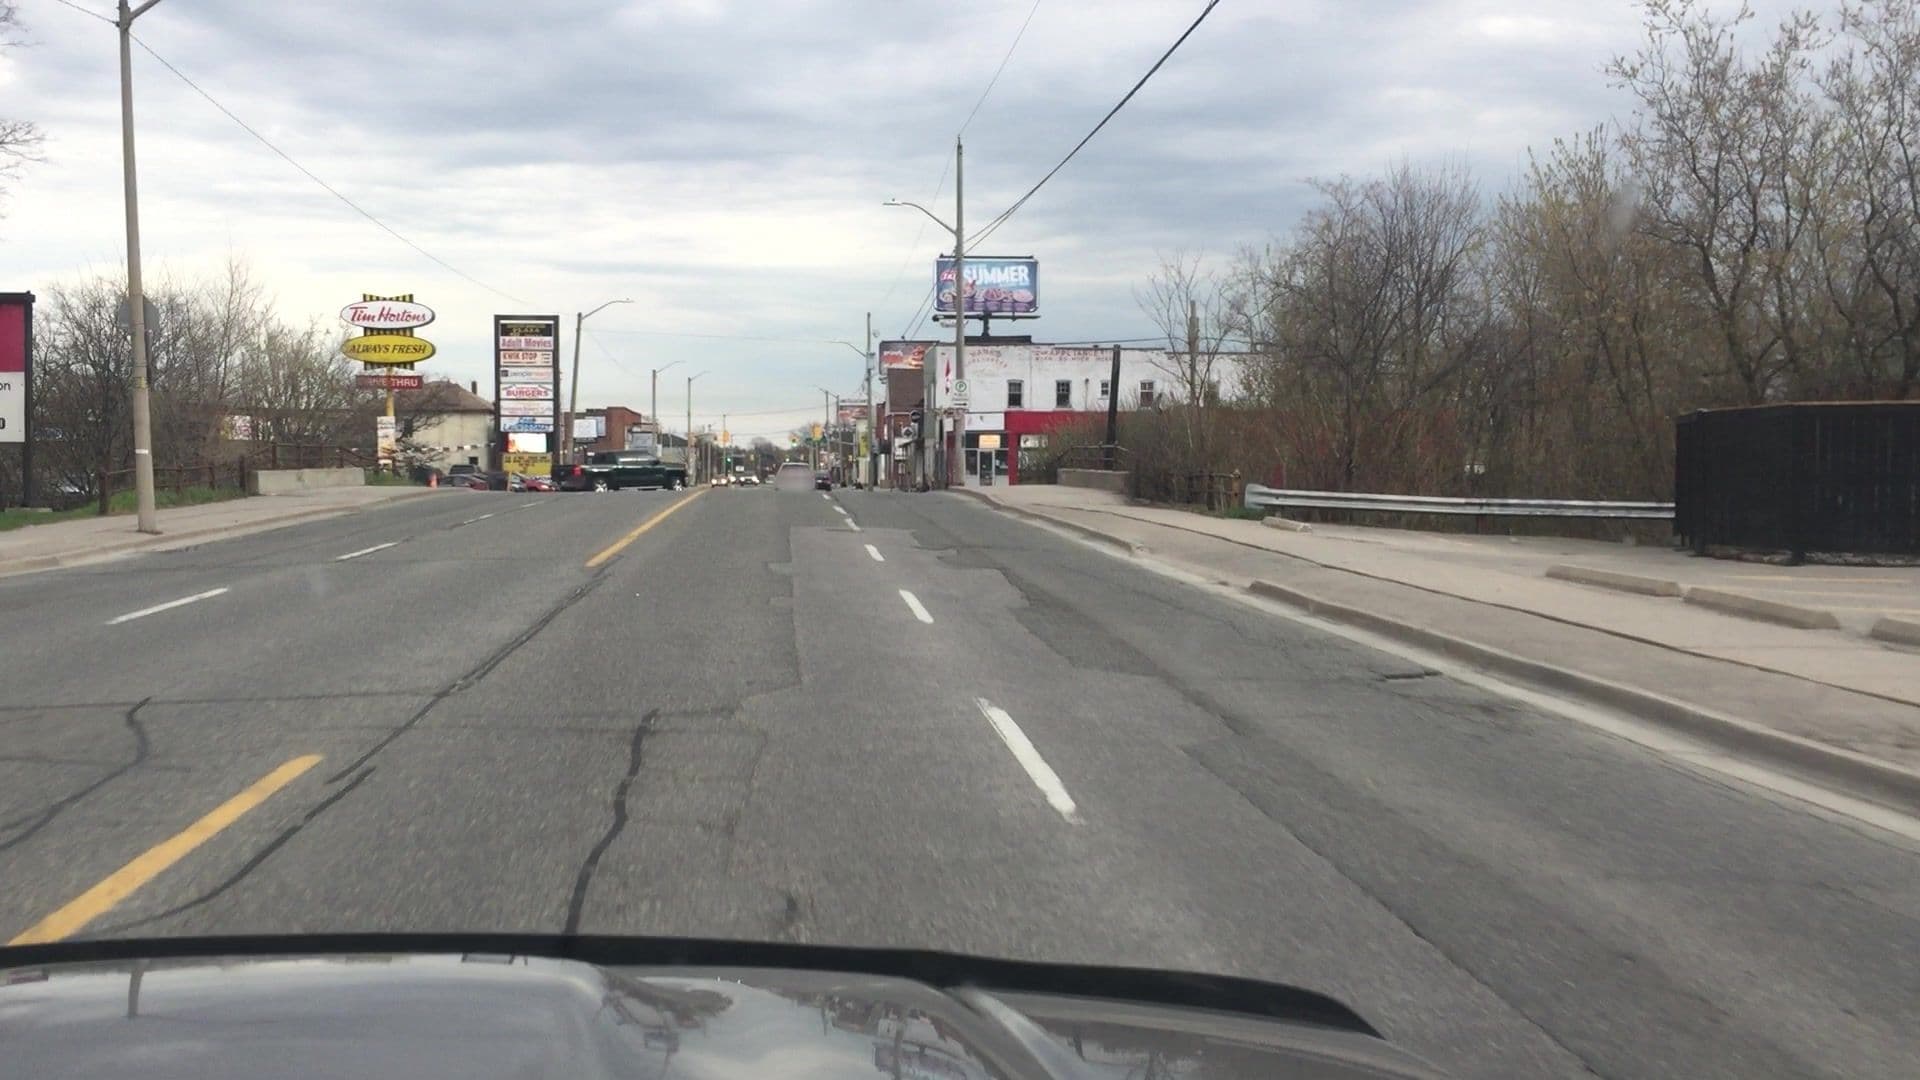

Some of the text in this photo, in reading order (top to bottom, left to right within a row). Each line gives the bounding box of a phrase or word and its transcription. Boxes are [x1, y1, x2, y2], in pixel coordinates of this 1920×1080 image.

[963, 264, 1030, 286] SUMMER
[349, 305, 427, 322] Tim Hortons
[501, 337, 553, 348] Adult Movies
[350, 343, 427, 354] ALWAYS FRESH
[521, 352, 538, 360] STOP
[391, 378, 419, 387] THRU
[506, 389, 549, 397] BURGERS
